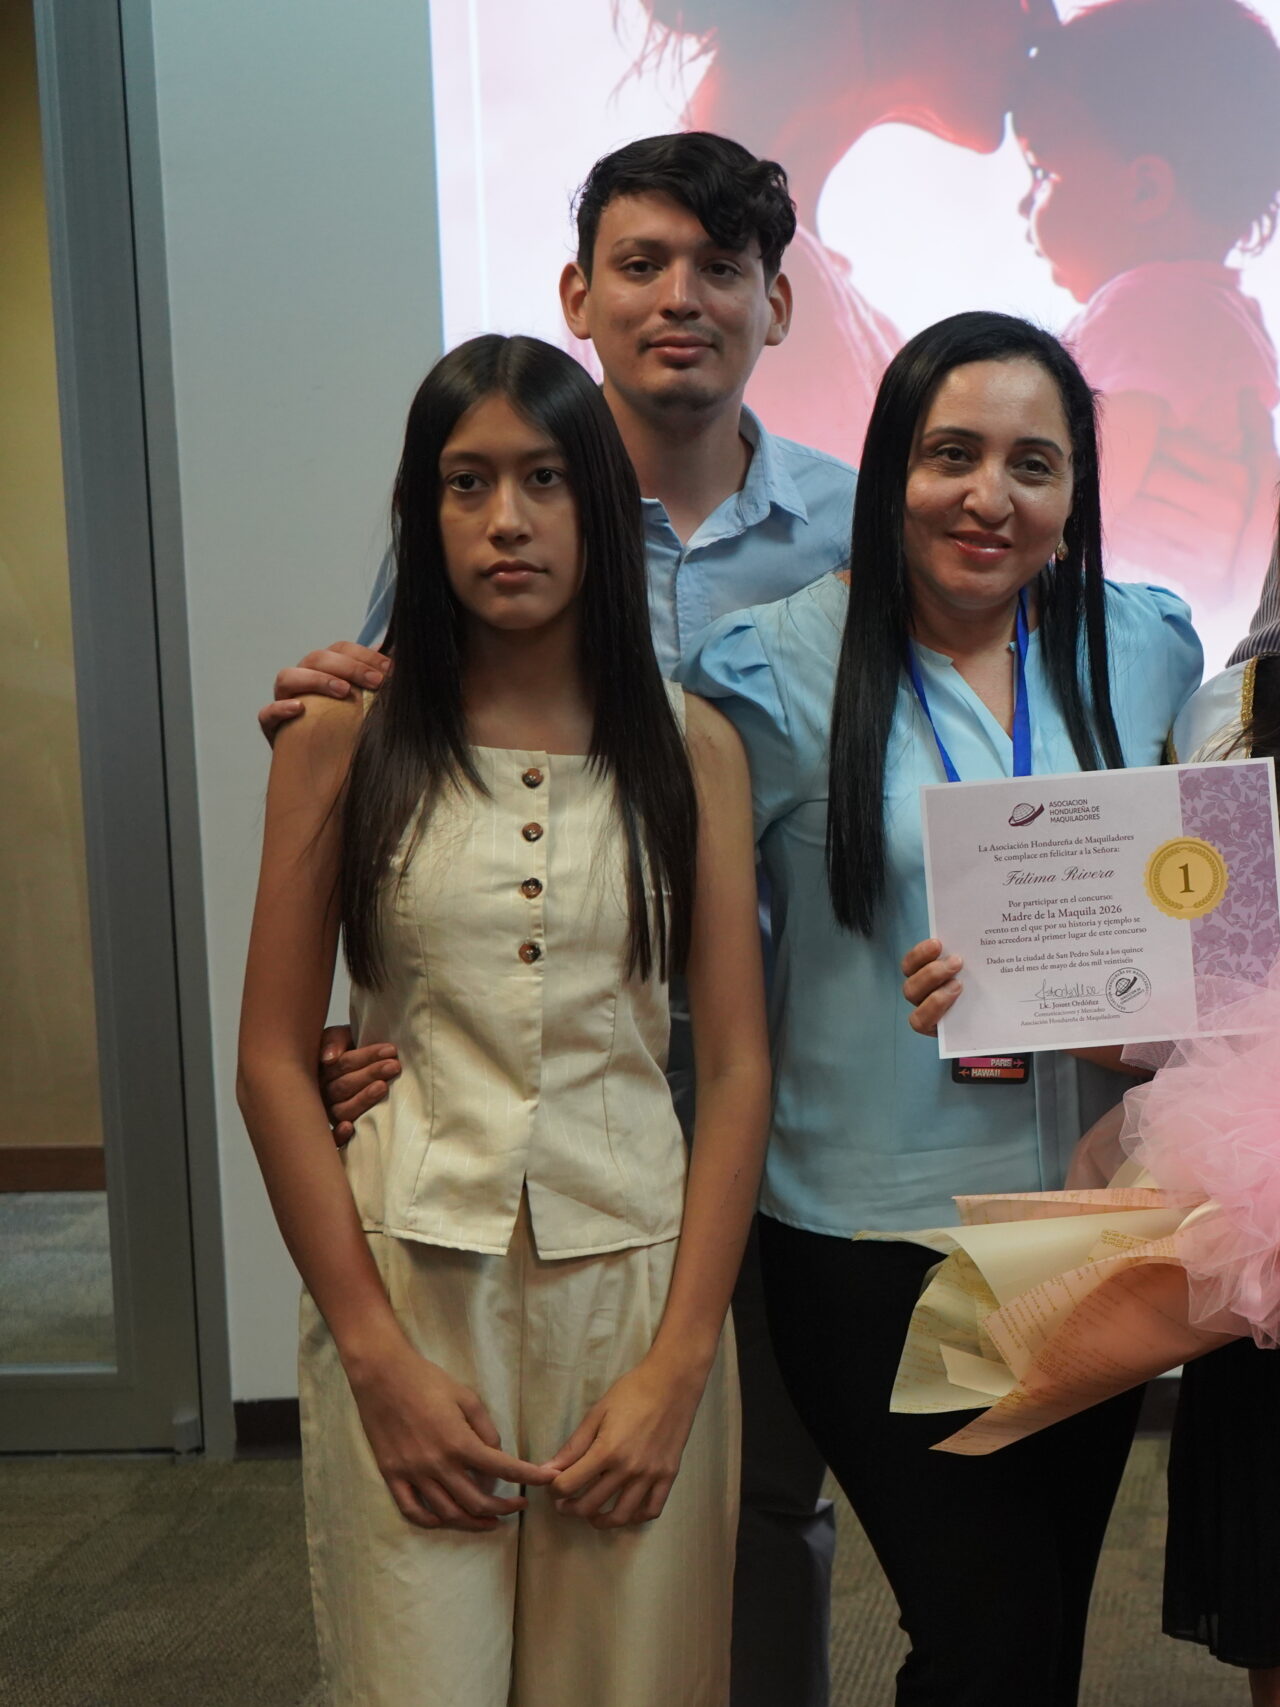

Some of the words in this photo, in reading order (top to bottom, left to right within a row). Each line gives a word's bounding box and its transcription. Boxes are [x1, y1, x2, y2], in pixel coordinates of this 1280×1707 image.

[1049, 799, 1088, 807] ASOCIACION
[1050, 806, 1089, 815] HONDUREÑA
[1051, 814, 1100, 823] MAQUILADORES
[989, 842, 1029, 851] Asociación
[1031, 839, 1073, 848] Hondureña
[1075, 837, 1083, 845] de
[1085, 833, 1134, 845] Maquiladores
[1004, 851, 1037, 862] complace
[1050, 848, 1077, 857] felicitar
[1093, 846, 1119, 854] Señora:
[1002, 869, 1056, 886] Fátima
[1061, 866, 1115, 881] Rivera
[1179, 863, 1195, 893] 1
[1008, 900, 1021, 908] Por
[1023, 897, 1058, 909] participar
[1002, 912, 1033, 922] Madre
[1034, 911, 1045, 920] de
[1048, 909, 1055, 919] la
[1058, 907, 1097, 919] Maquila
[1099, 905, 1122, 915] 2026
[985, 927, 1009, 935] evento
[1021, 924, 1027, 932] el
[1029, 925, 1042, 934] que
[1044, 923, 1057, 932] por
[1068, 919, 1096, 928] historia
[1097, 920, 1101, 928] y
[1104, 917, 1132, 926] ejemplo
[980, 938, 996, 946] hizo
[998, 935, 1032, 944] acreedora
[1042, 933, 1066, 943] primer
[1068, 931, 1086, 941] lugar
[1114, 927, 1147, 935] concurso
[987, 957, 1004, 965] Dado
[1023, 953, 1045, 962] ciudad
[1070, 949, 1089, 958] Pedro
[1090, 948, 1104, 956] Sula
[1122, 947, 1143, 955] quince
[1000, 965, 1013, 973] días
[1015, 964, 1024, 972] del
[1050, 963, 1068, 971] mayo
[1069, 960, 1077, 968] de
[1078, 959, 1090, 967] dos
[991, 1059, 1012, 1067] PARIS
[971, 1068, 1000, 1077] HAWAII
